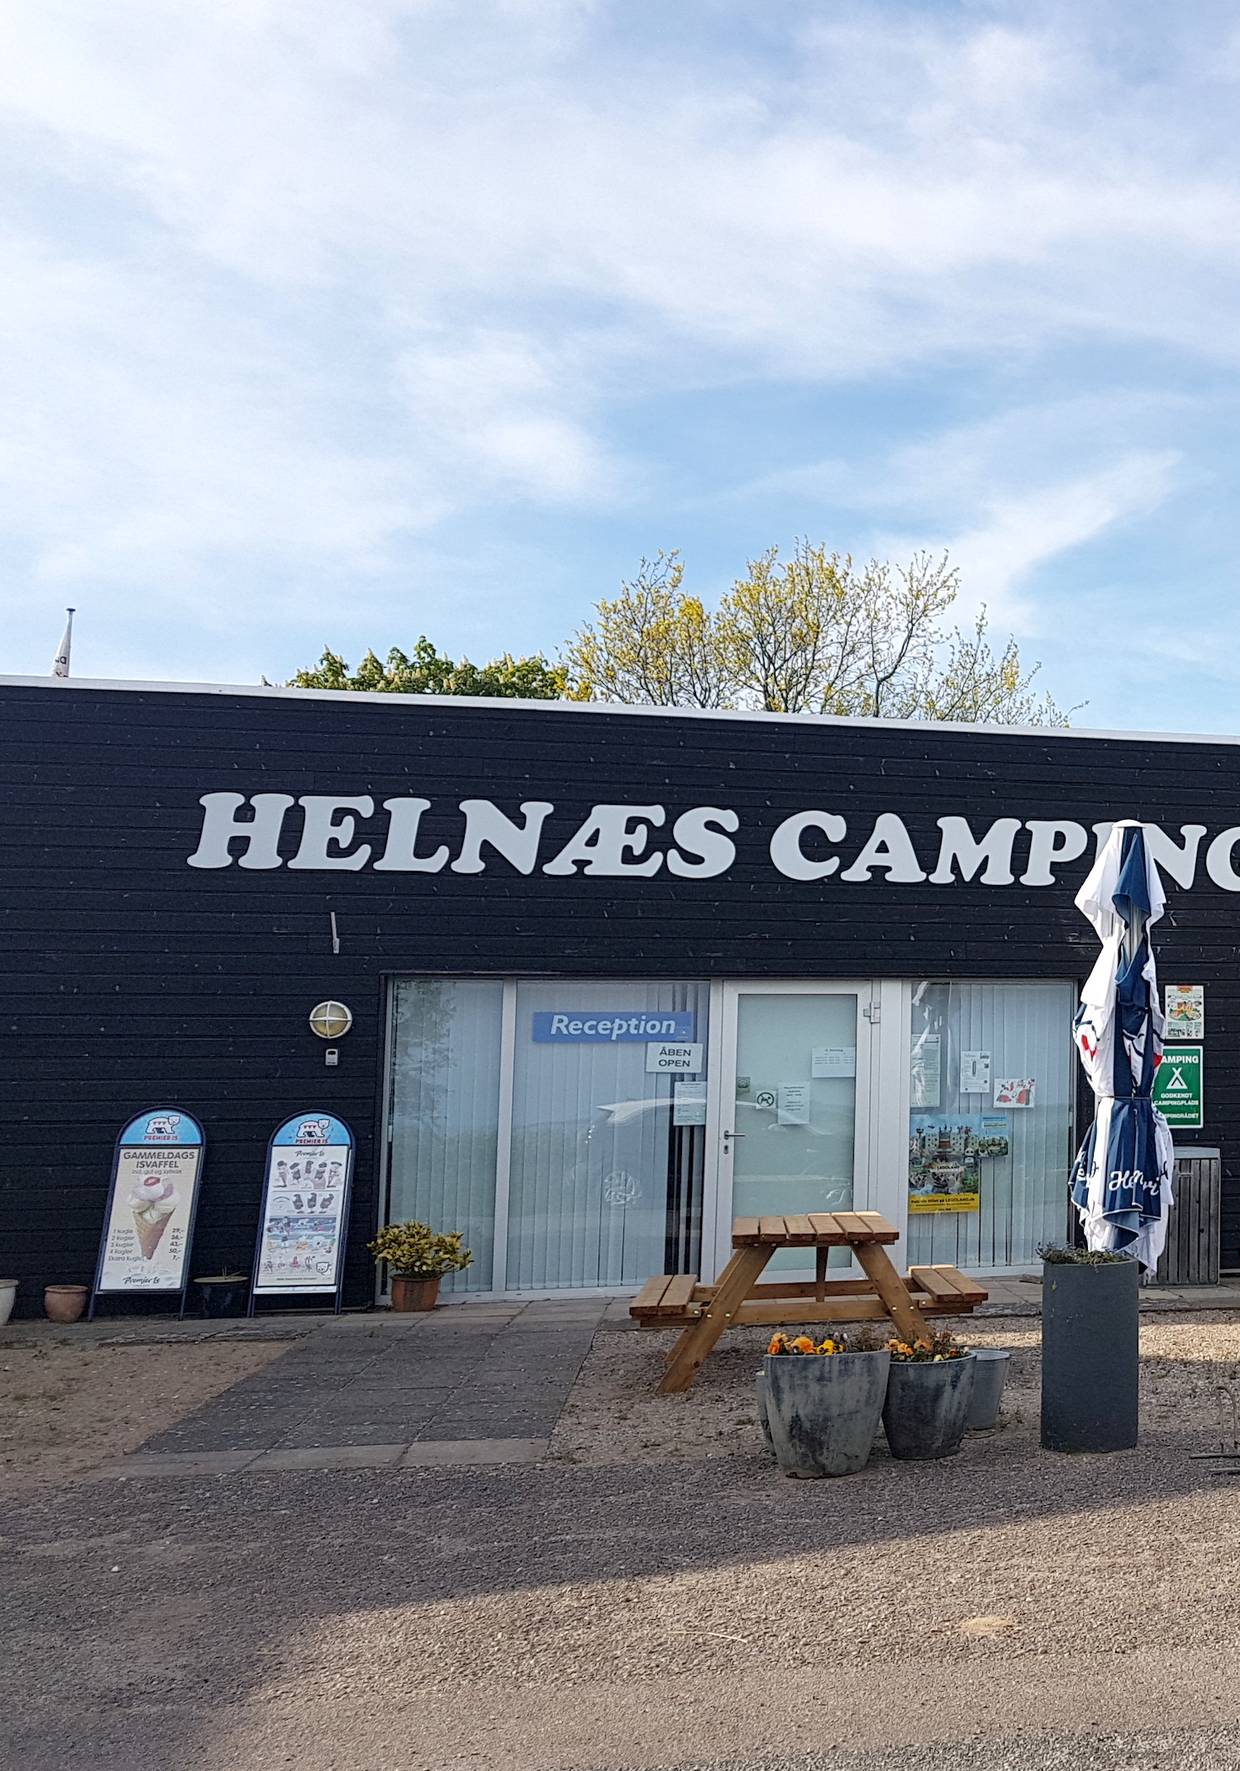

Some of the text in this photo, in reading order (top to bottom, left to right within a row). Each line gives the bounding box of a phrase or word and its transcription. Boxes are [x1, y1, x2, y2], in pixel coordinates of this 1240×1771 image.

[186, 792, 739, 878] HELNÆS
[550, 1014, 676, 1041] Reception
[659, 1046, 692, 1057] ÅBEN
[658, 1058, 691, 1068] OPEN
[1162, 1055, 1199, 1064] AMPING
[123, 1151, 195, 1160] GAMMELDAGS
[136, 1160, 180, 1169] ISVAFFEL
